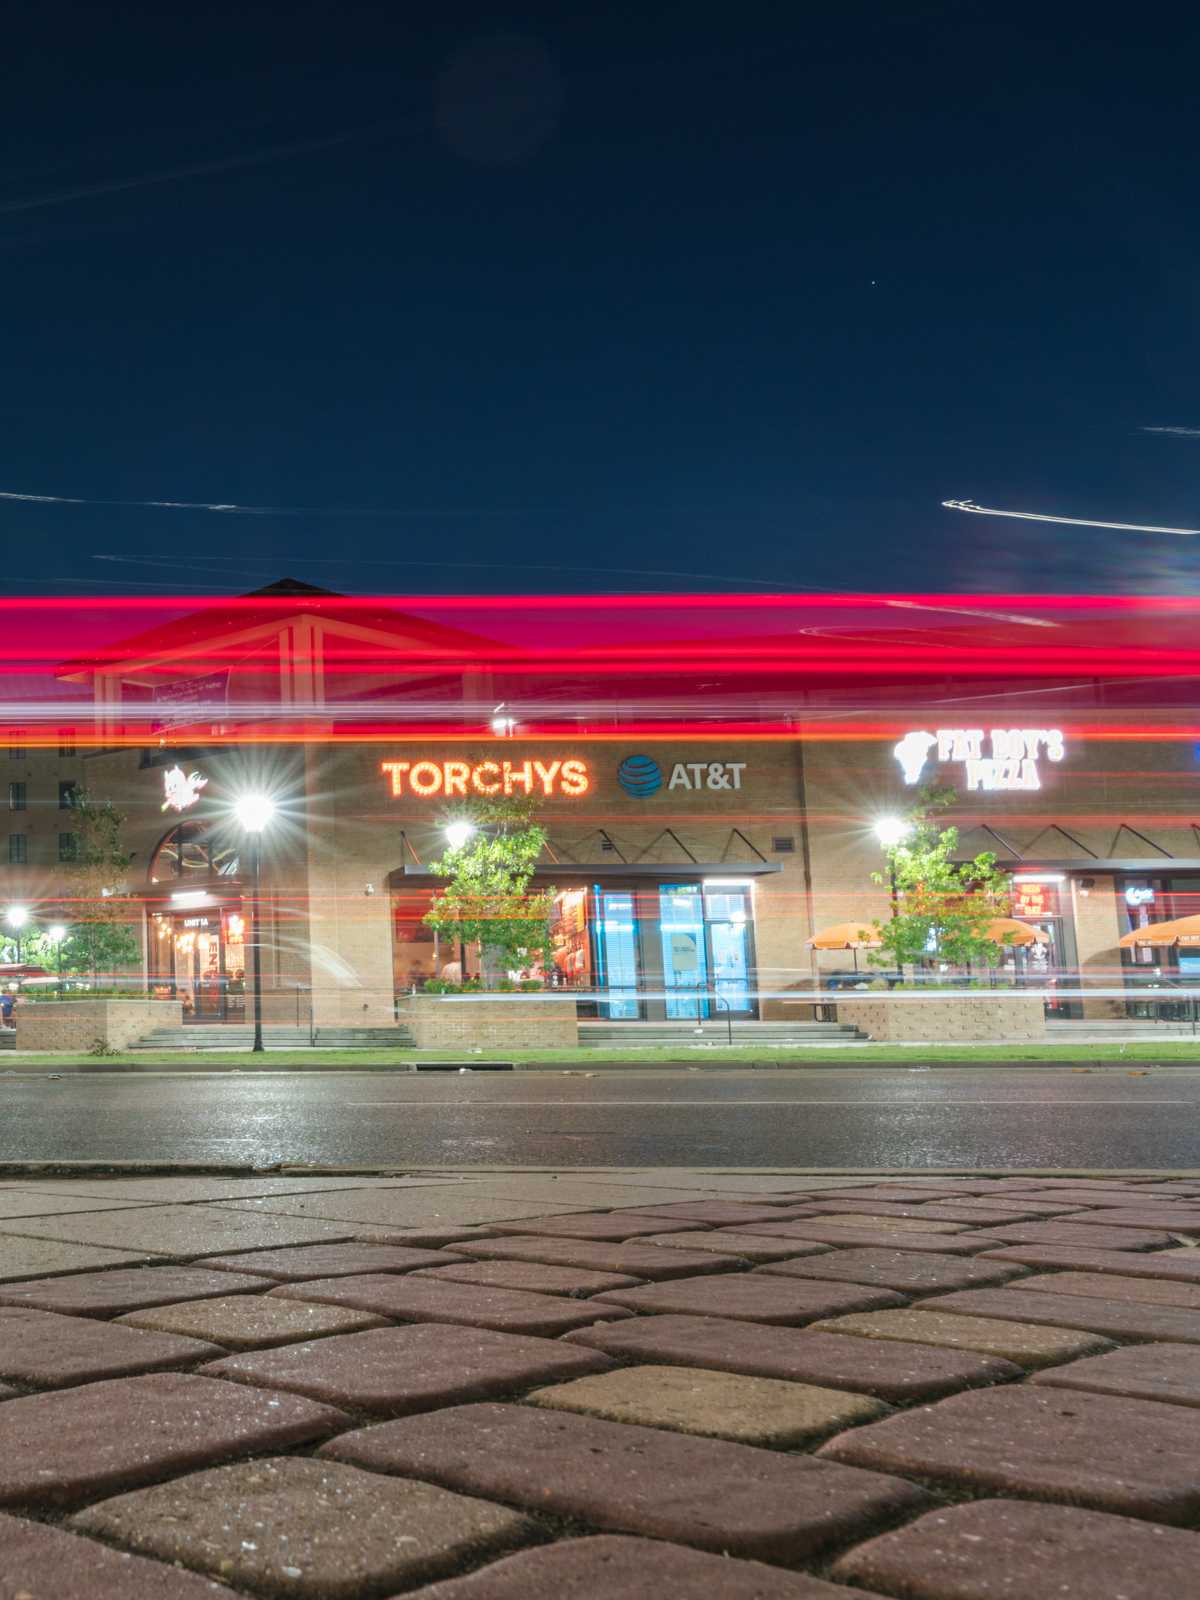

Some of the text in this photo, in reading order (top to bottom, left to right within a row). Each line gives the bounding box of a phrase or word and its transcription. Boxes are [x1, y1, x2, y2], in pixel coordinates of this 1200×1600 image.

[937, 730, 984, 760] FAT
[380, 759, 589, 797] TORCHYS
[667, 762, 746, 790] AT&T
[966, 759, 1040, 790] PIZZA
